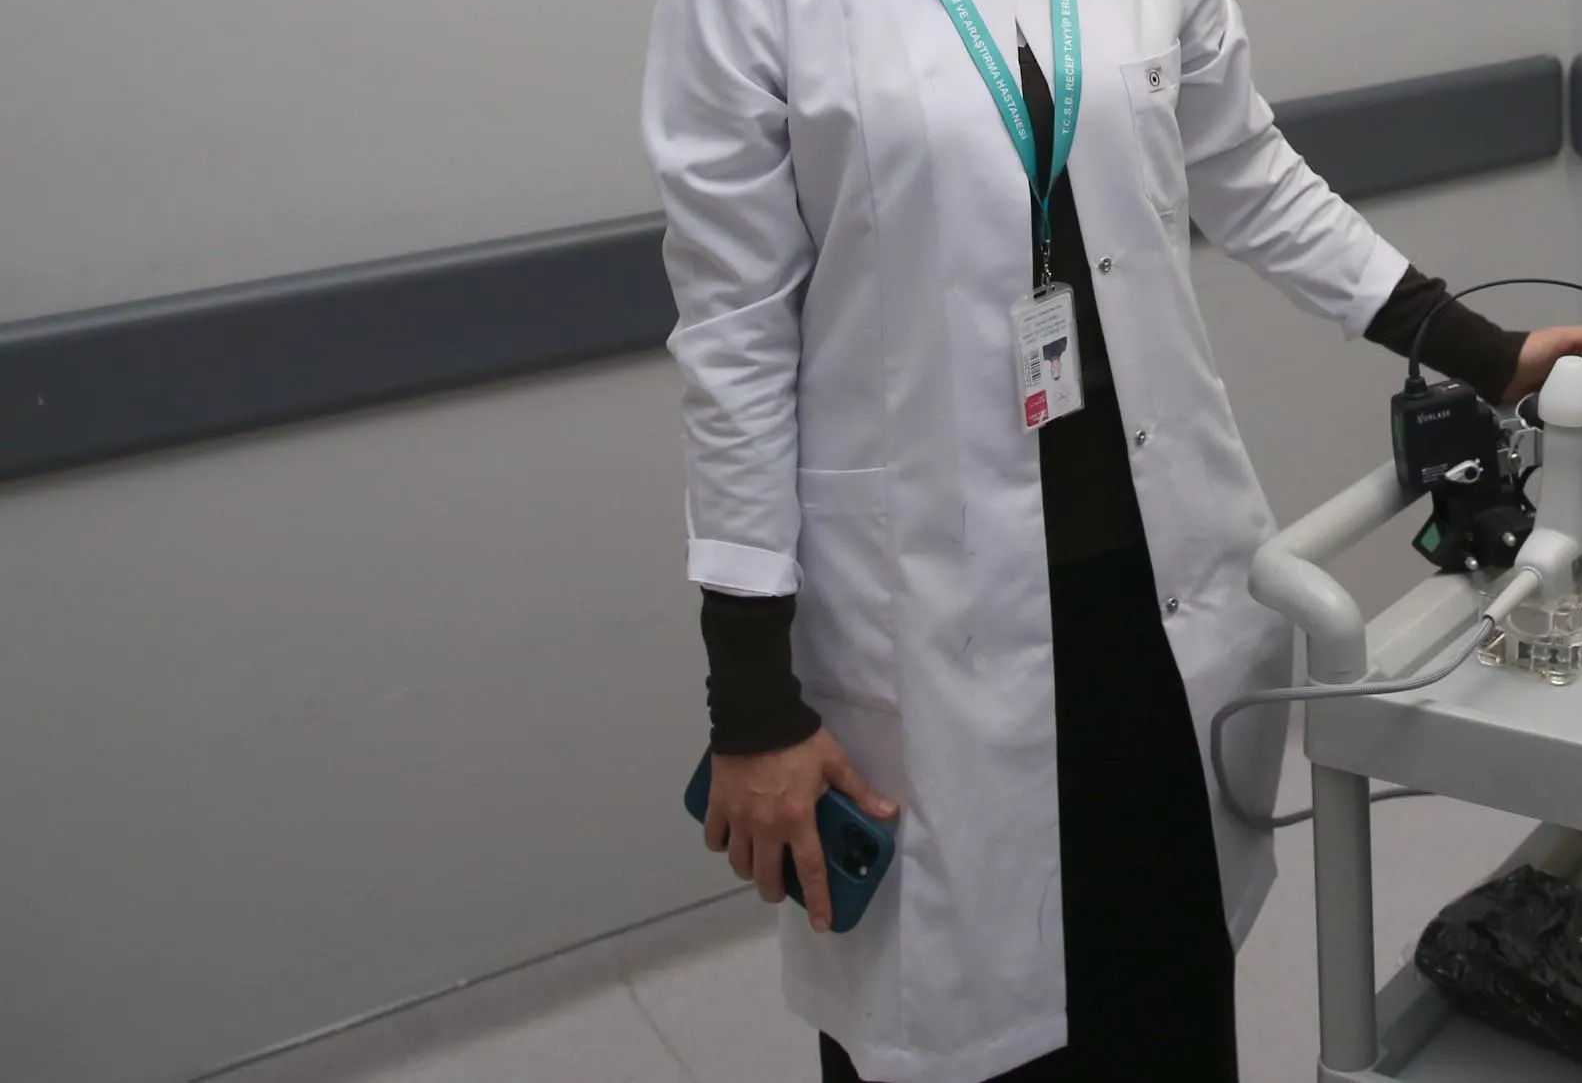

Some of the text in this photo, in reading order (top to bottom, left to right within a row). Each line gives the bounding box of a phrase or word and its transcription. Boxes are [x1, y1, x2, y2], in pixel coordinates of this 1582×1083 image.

[956, 3, 969, 18] VE
[963, 18, 1001, 80] ARAŞTIRMA
[1064, 54, 1074, 91] RECEP
